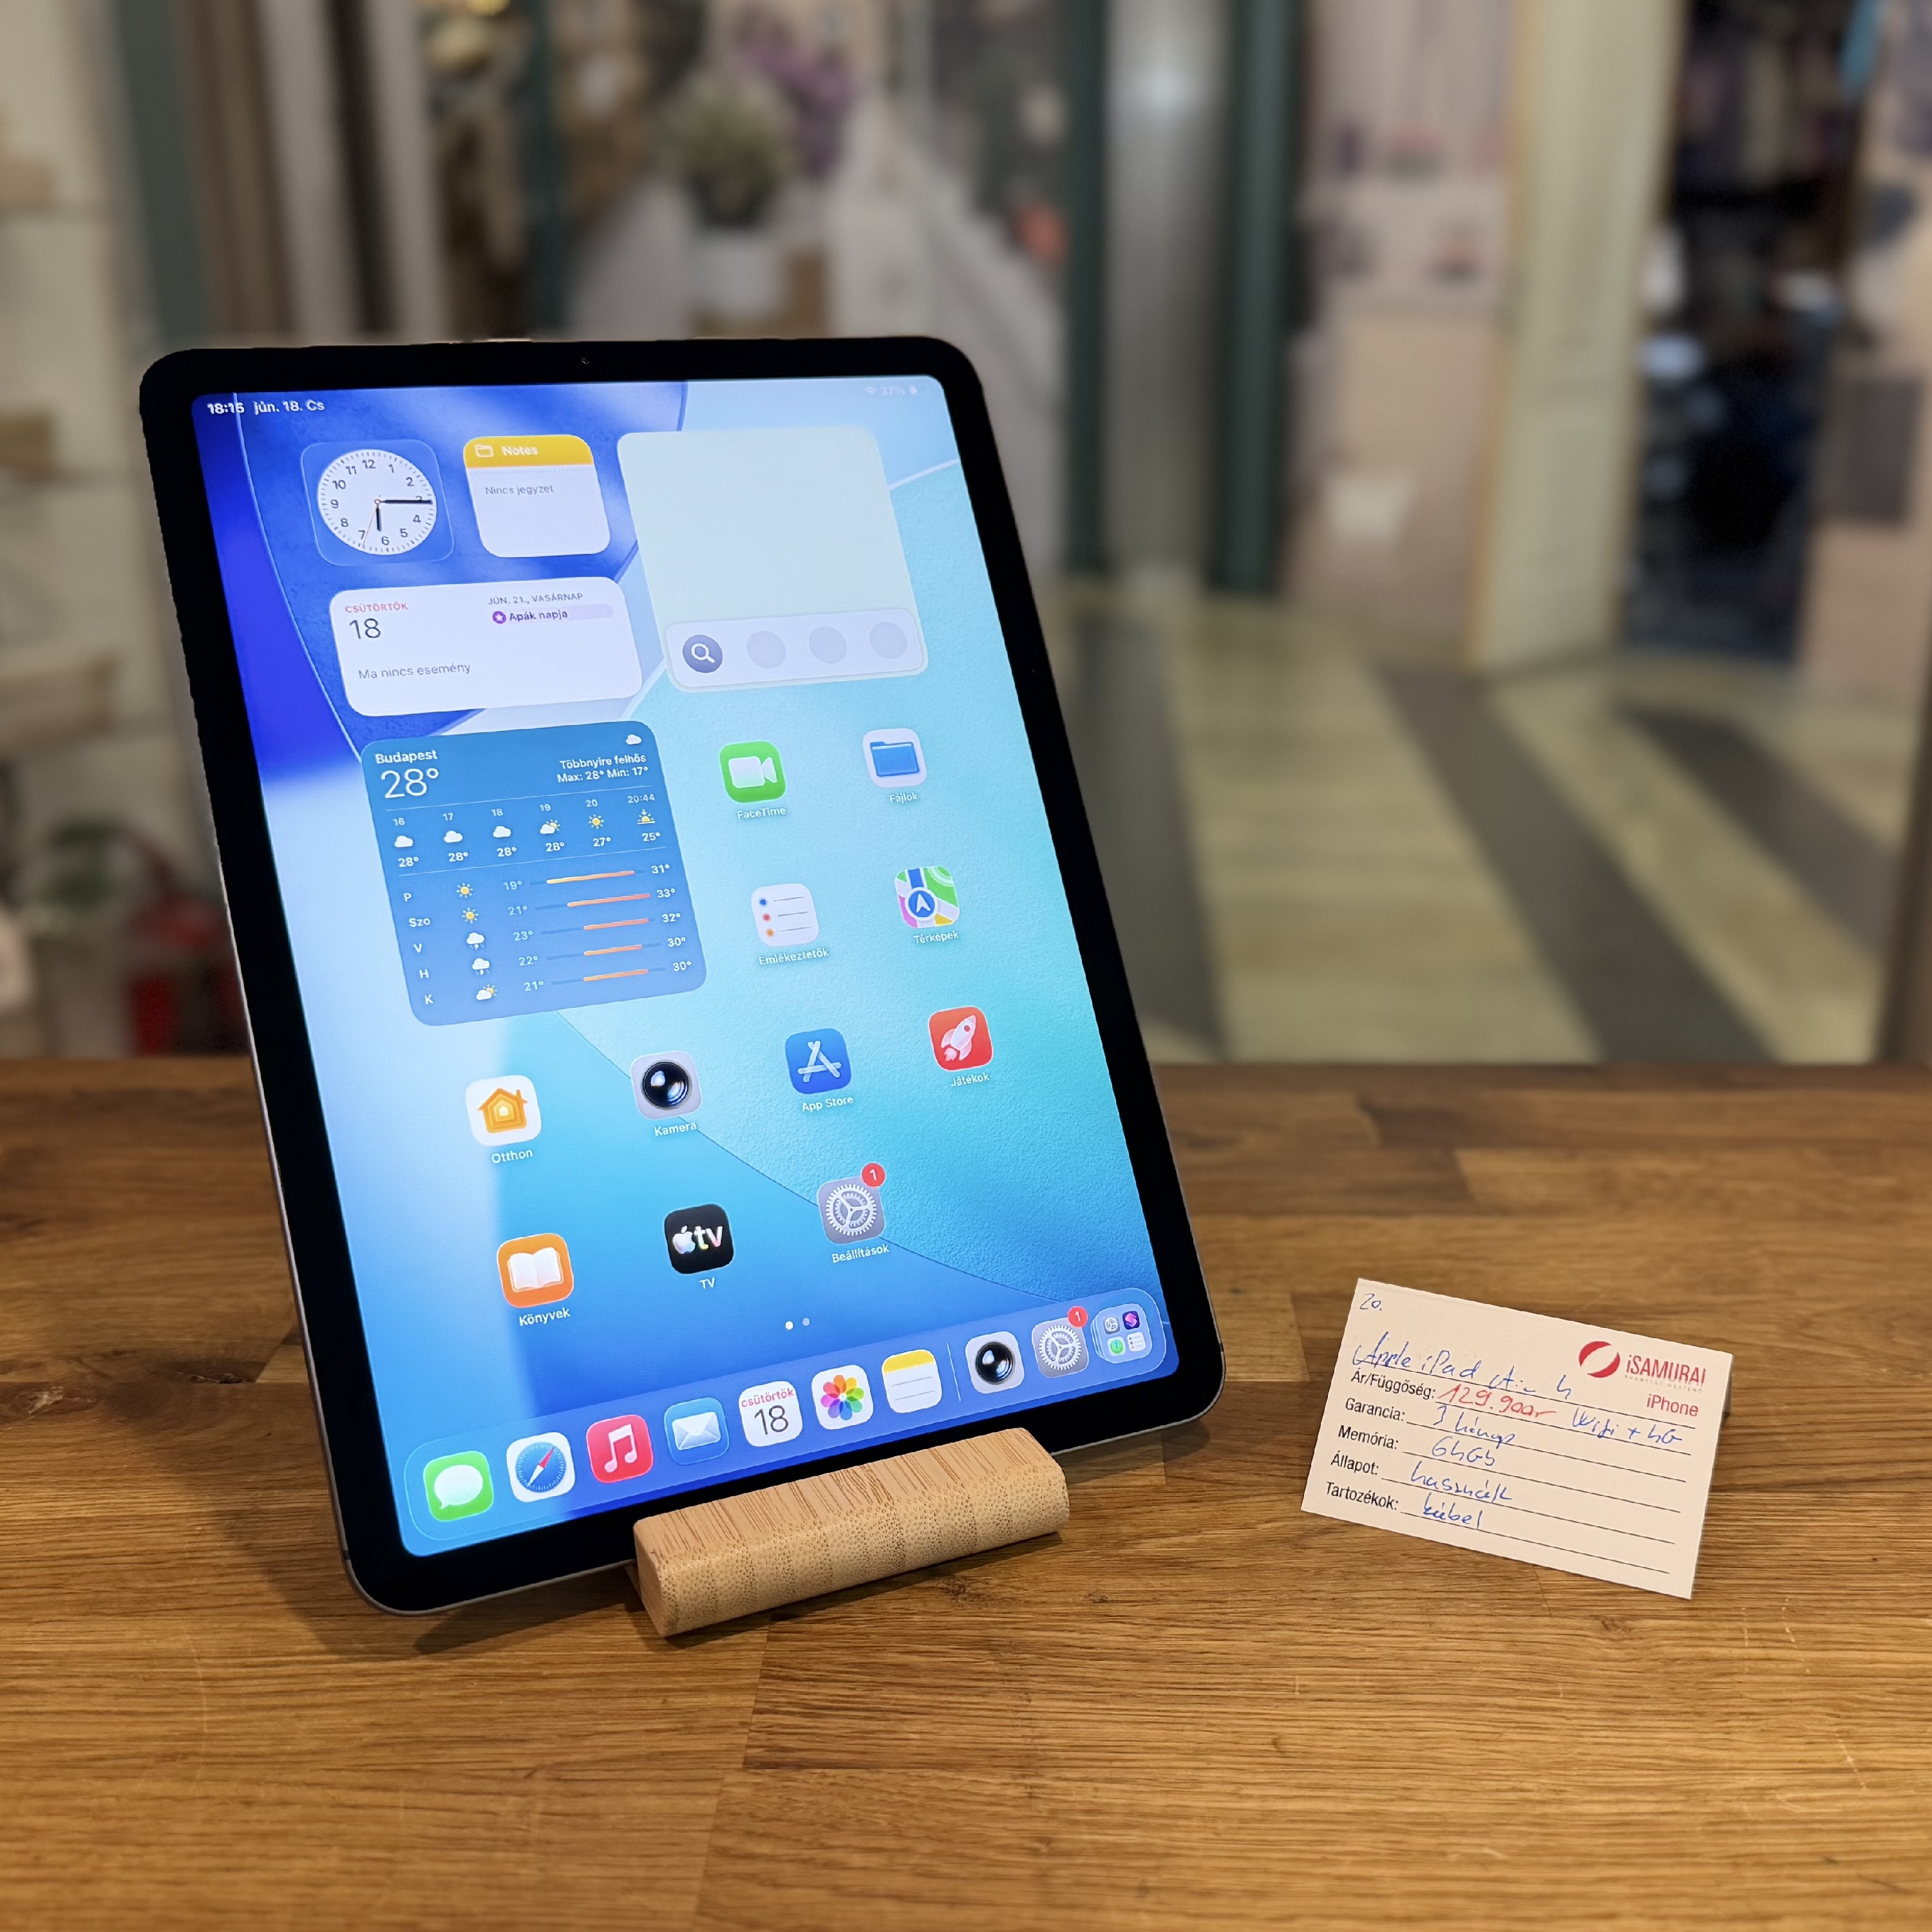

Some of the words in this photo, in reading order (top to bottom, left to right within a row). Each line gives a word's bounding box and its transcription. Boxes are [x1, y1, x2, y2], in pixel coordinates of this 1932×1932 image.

[207, 402, 245, 414] 18:15
[253, 401, 279, 415] jún.
[283, 401, 303, 412] 18.
[306, 399, 325, 412] Cs
[502, 446, 538, 456] Notes
[362, 459, 375, 469] 12
[388, 464, 394, 473] 1
[345, 466, 357, 475] 11
[332, 480, 346, 489] 10
[406, 477, 414, 486] 2
[516, 485, 554, 495] jegyzet
[330, 500, 339, 509] 9
[341, 518, 348, 527] 8
[413, 515, 421, 524] 4
[359, 530, 366, 540] 7
[400, 529, 408, 538] 5
[381, 536, 390, 545] 6
[488, 596, 511, 605] JÚN.
[531, 592, 583, 602] VASÁRNAP
[345, 601, 408, 613] CSÜTÖRTÖK
[509, 611, 536, 621] Apák
[539, 610, 568, 621] napja
[349, 618, 381, 639] 18
[358, 670, 377, 679] Ma
[382, 668, 413, 677] nincs
[417, 663, 470, 675] esemény
[375, 750, 438, 764] Budapest
[560, 758, 612, 770] Többnyire
[557, 774, 583, 782] Max:
[585, 771, 604, 780] 28°
[607, 768, 629, 778] Min:
[632, 766, 649, 775] 17°
[381, 768, 439, 799] 28°
[586, 799, 598, 808] 20
[627, 794, 655, 804] 20:44
[889, 792, 918, 803] Fájlok
[443, 813, 453, 821] 17
[737, 807, 787, 819] FaceTime
[593, 837, 611, 847] 27°
[642, 832, 660, 841] 25°
[497, 847, 517, 857] 28°
[545, 842, 565, 852] 28°
[399, 857, 419, 867] 28°
[449, 852, 469, 862] 28°
[403, 893, 412, 902] P
[503, 880, 523, 890] 19°
[651, 864, 670, 874] 31°
[409, 918, 431, 927] Szo
[508, 905, 528, 916] 21°
[657, 889, 676, 898] 33°
[413, 943, 422, 952] V
[513, 931, 533, 941] 23°
[662, 913, 681, 922] 32°
[914, 931, 959, 944] Térképek
[419, 969, 430, 978] H
[519, 956, 538, 966] 22°
[668, 937, 686, 947] 30°
[425, 994, 433, 1005] K
[524, 981, 544, 991] 21°
[673, 961, 692, 971] 30°
[951, 1072, 990, 1087] Játékok
[802, 1101, 823, 1113] App
[826, 1096, 854, 1108] Store
[654, 1122, 697, 1136] Kamera
[491, 1148, 533, 1164] Otthon
[870, 1170, 877, 1180] 1
[831, 1244, 889, 1263] Beállítások
[699, 1277, 715, 1289] TV
[519, 1307, 571, 1326] Könyvek
[1075, 1311, 1081, 1321] 1
[1352, 1331, 1410, 1368] Apple
[1421, 1350, 1482, 1379] iPad
[1626, 1354, 1706, 1384] iSAMURAI
[1351, 1368, 1436, 1400] Ár/Függőség:
[741, 1388, 794, 1407] csütörtök
[1345, 1397, 1405, 1421] Garancia:
[1433, 1405, 1447, 1425] 3
[1647, 1394, 1699, 1417] iPhone
[754, 1405, 788, 1435] 18
[1338, 1425, 1399, 1450] Memória:
[1331, 1450, 1379, 1475] Állapot:
[1327, 1481, 1399, 1510] Tartozékok:
